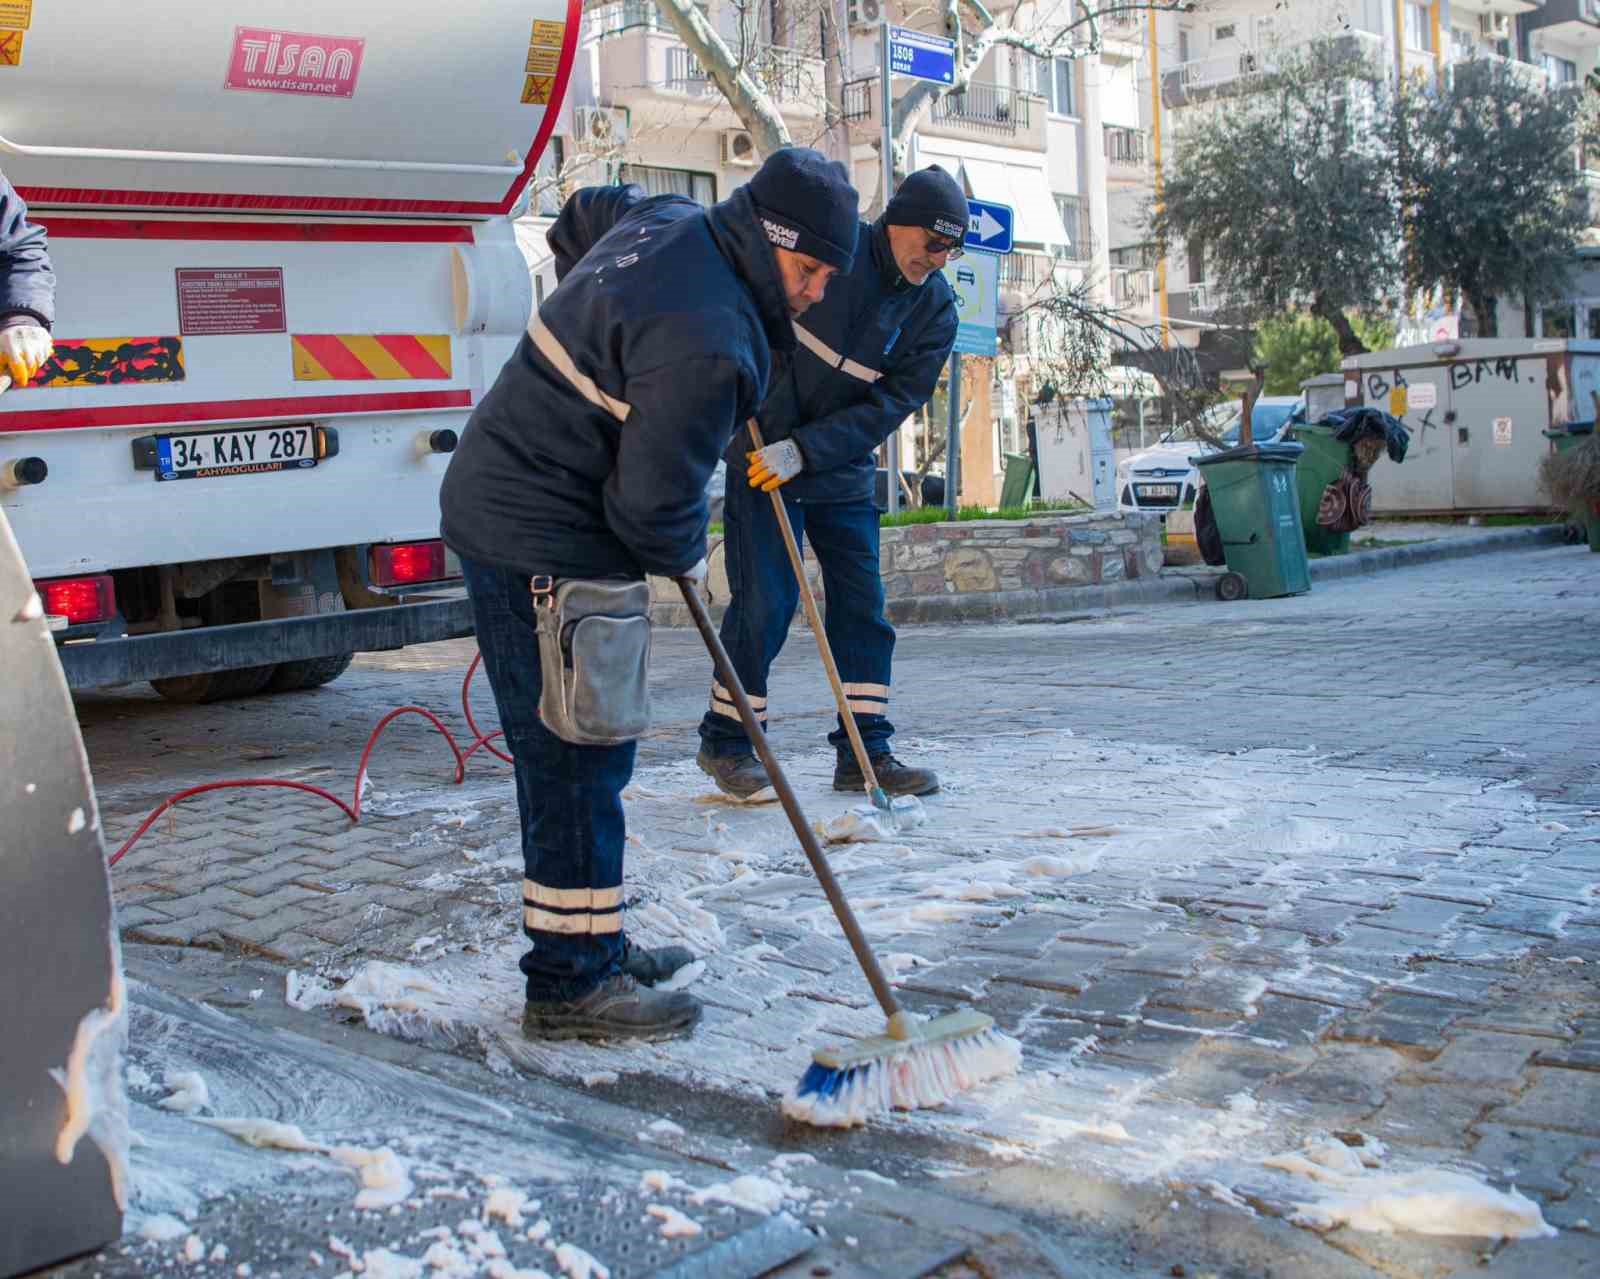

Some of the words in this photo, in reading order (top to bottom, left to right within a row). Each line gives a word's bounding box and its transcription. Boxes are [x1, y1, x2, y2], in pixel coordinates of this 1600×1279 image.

[247, 77, 337, 93] www.tisan.net
[173, 438, 203, 468] 34
[213, 433, 257, 465] KAY
[269, 429, 308, 460] 287
